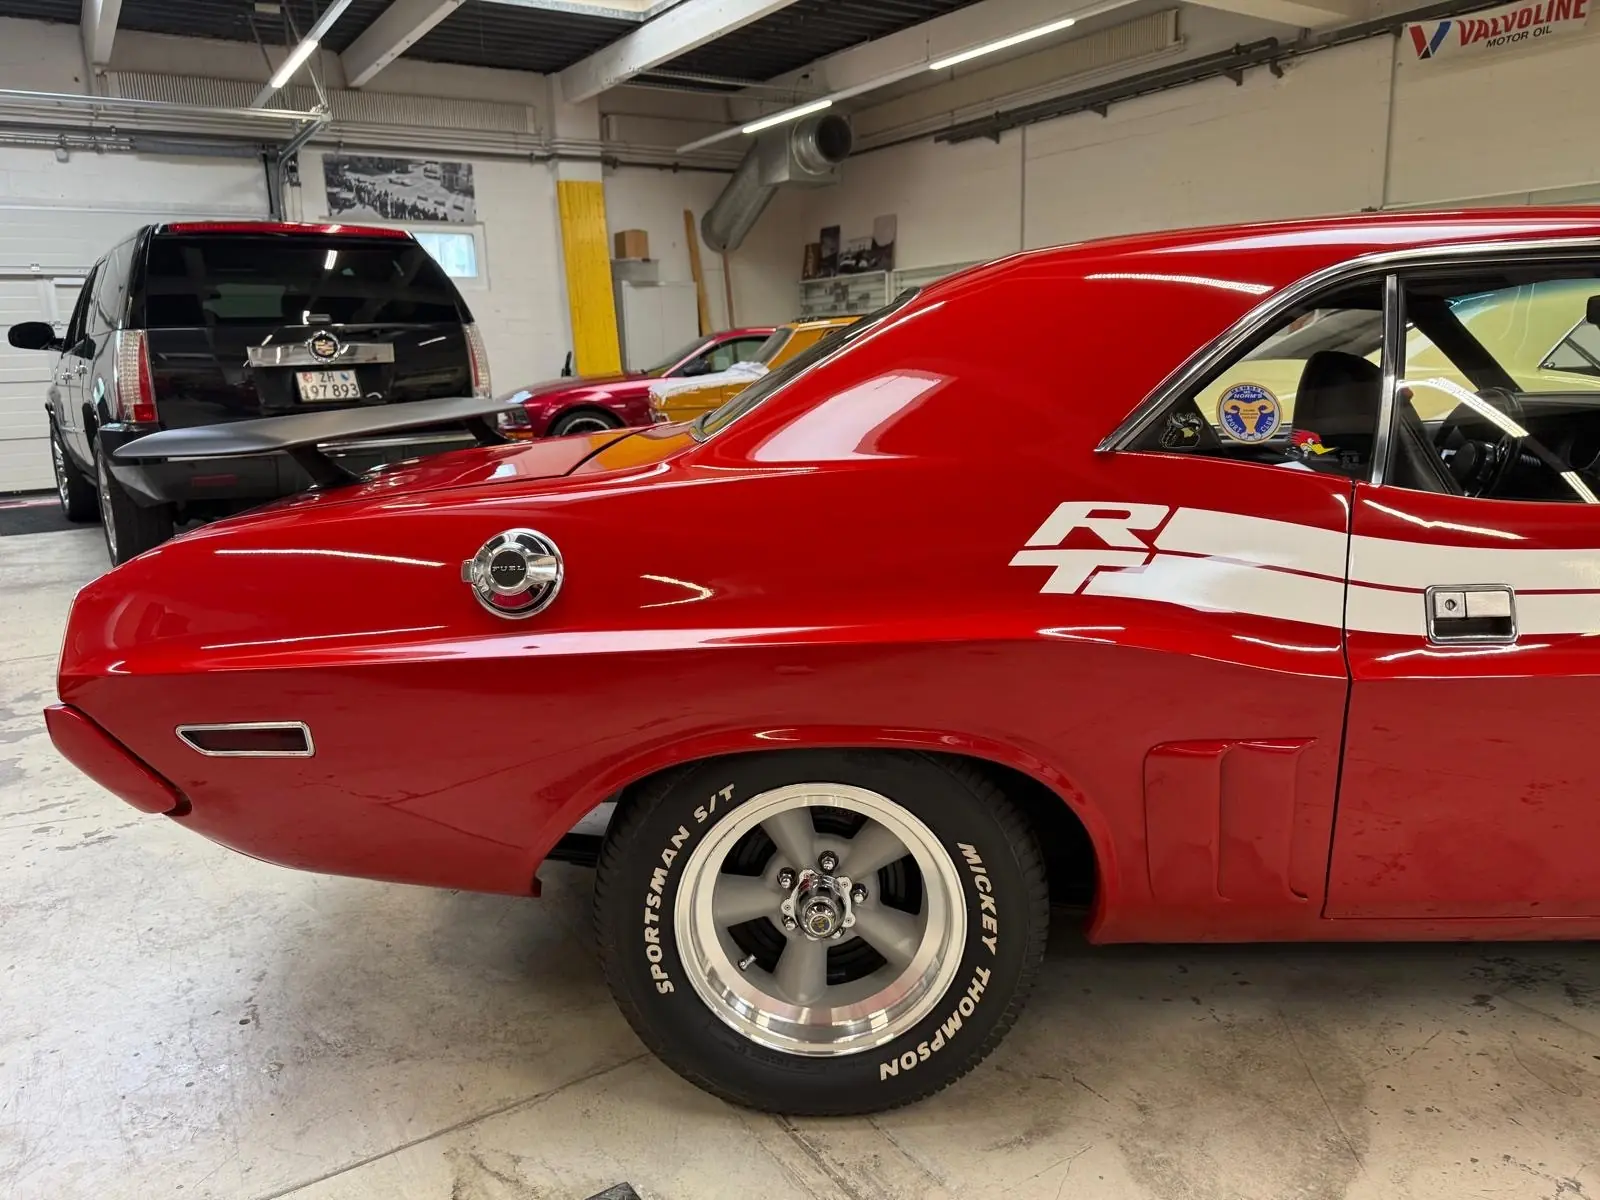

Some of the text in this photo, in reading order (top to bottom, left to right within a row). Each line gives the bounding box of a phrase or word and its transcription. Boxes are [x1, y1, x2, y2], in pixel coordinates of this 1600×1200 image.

[1456, 0, 1587, 46] VALVOLINE
[1486, 25, 1552, 48] MOTOR OIL
[320, 372, 335, 382] ZH
[301, 383, 359, 400] 197 893
[1226, 414, 1274, 433] SPORT CLUB
[644, 783, 735, 994] SPORTSMAN S/T
[879, 842, 998, 1081] MICKEY THOMPSON
